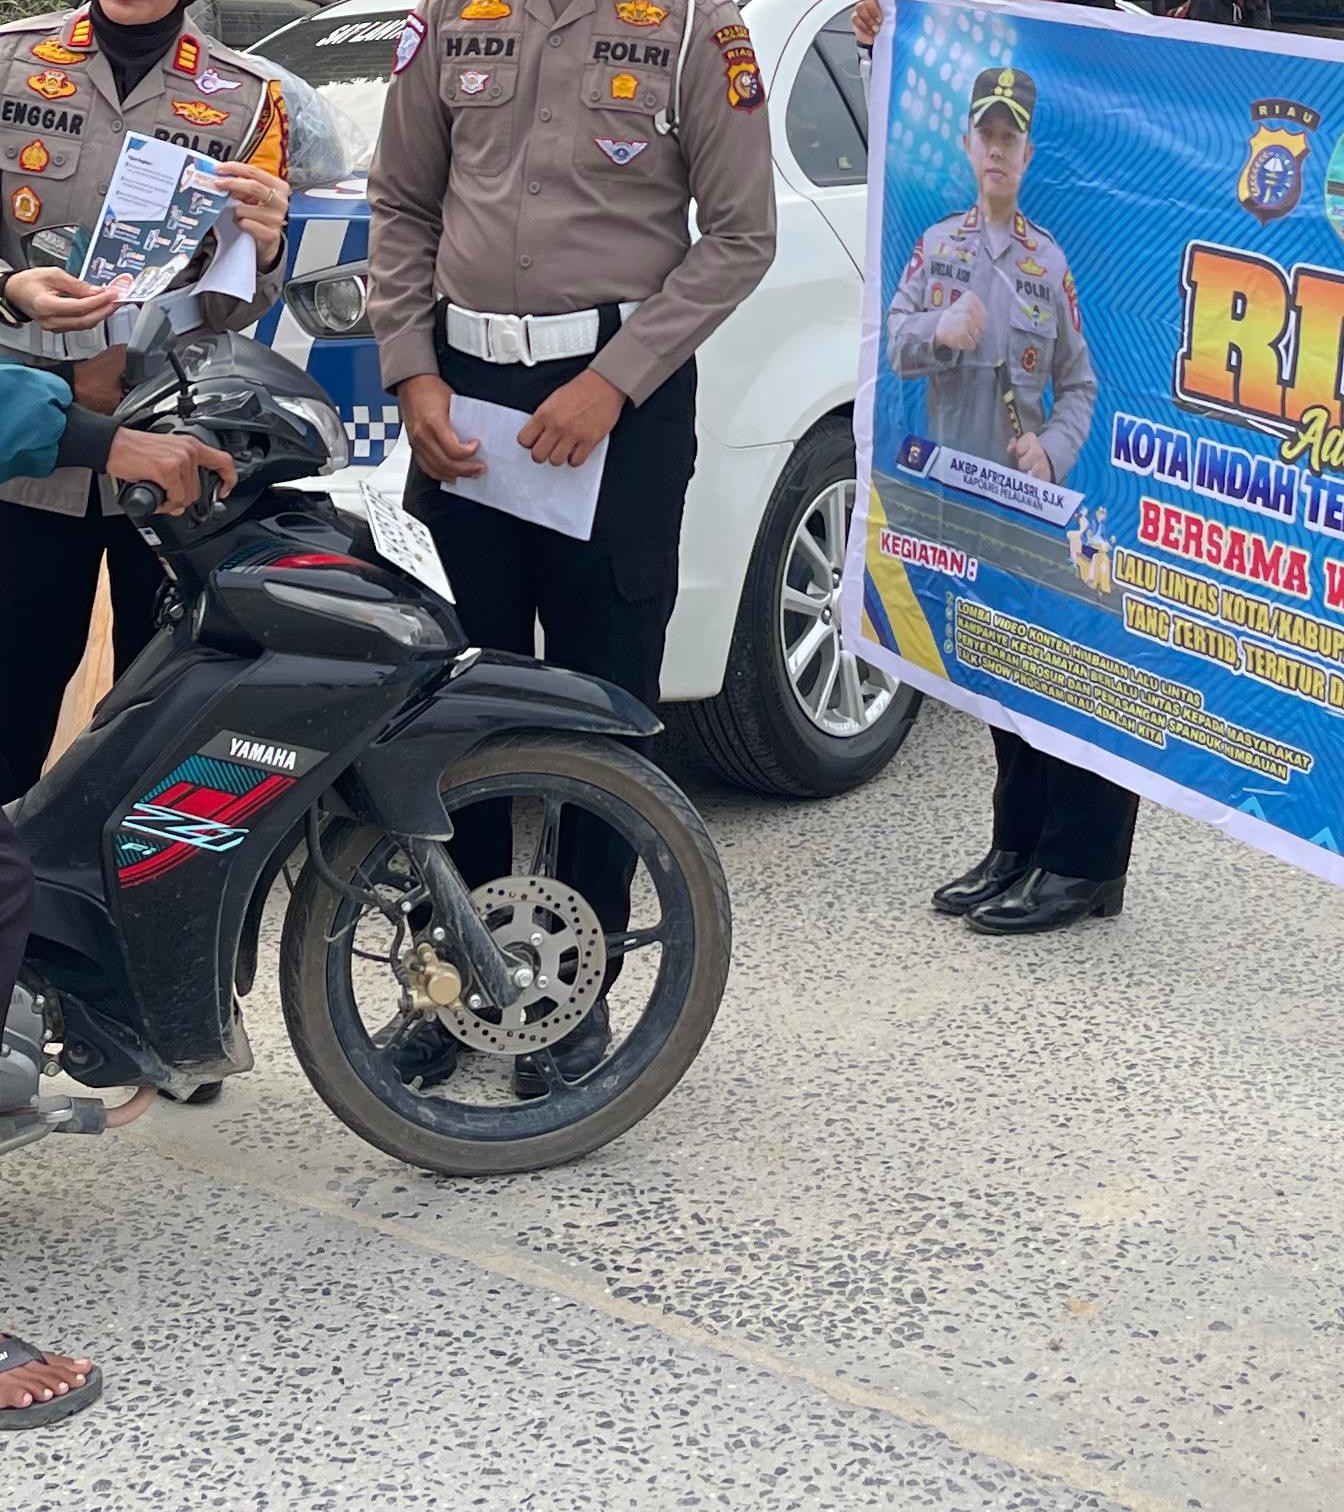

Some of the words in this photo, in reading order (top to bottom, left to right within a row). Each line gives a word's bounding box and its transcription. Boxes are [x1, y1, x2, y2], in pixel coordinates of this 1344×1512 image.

[447, 36, 515, 57] HADI
[594, 39, 670, 67] POLRI
[1, 100, 84, 136] ENGGAR
[1258, 105, 1313, 124] RIAU
[1016, 279, 1050, 302] POLRI
[949, 457, 978, 477] AKBP
[1113, 414, 1192, 485] KOTA
[1196, 440, 1296, 514] INDAH
[881, 529, 965, 576] KEGIATAN
[1139, 499, 1312, 597] BERSAMA
[1115, 548, 1157, 591] LALU
[1159, 561, 1219, 613] LINTAS
[981, 655, 1012, 679] SHOW
[994, 612, 1027, 637] VIDEO
[1160, 680, 1202, 709] LINTAS
[1126, 596, 1172, 640] YANG
[1173, 618, 1243, 672] TERTIB,
[1244, 640, 1326, 704] TERATUR
[229, 737, 297, 771] YAMAHA
